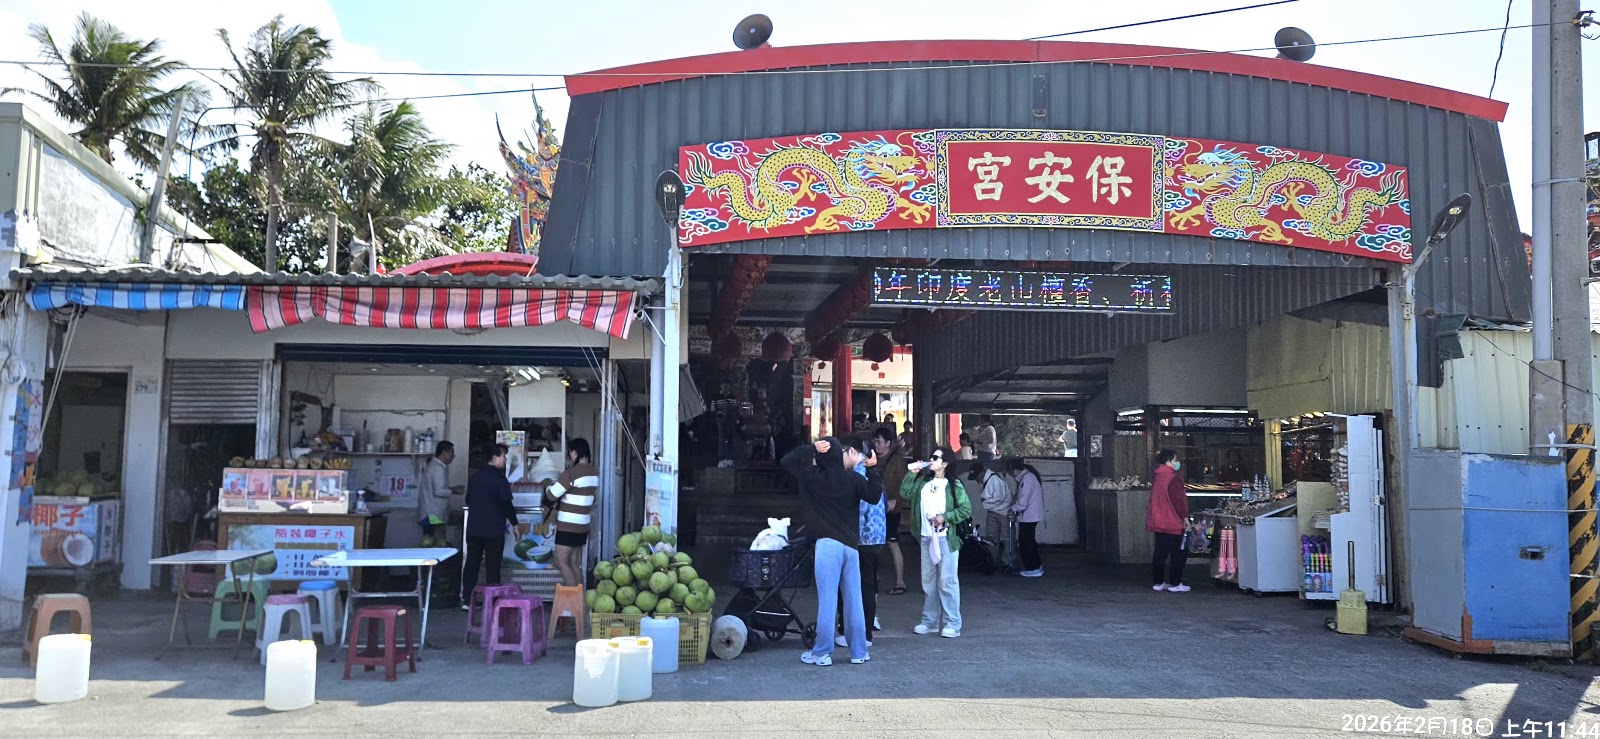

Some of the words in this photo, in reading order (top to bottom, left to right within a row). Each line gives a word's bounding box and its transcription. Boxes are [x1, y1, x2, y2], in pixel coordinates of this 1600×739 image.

[968, 150, 1133, 204] 保安宮
[388, 477, 405, 491] 18
